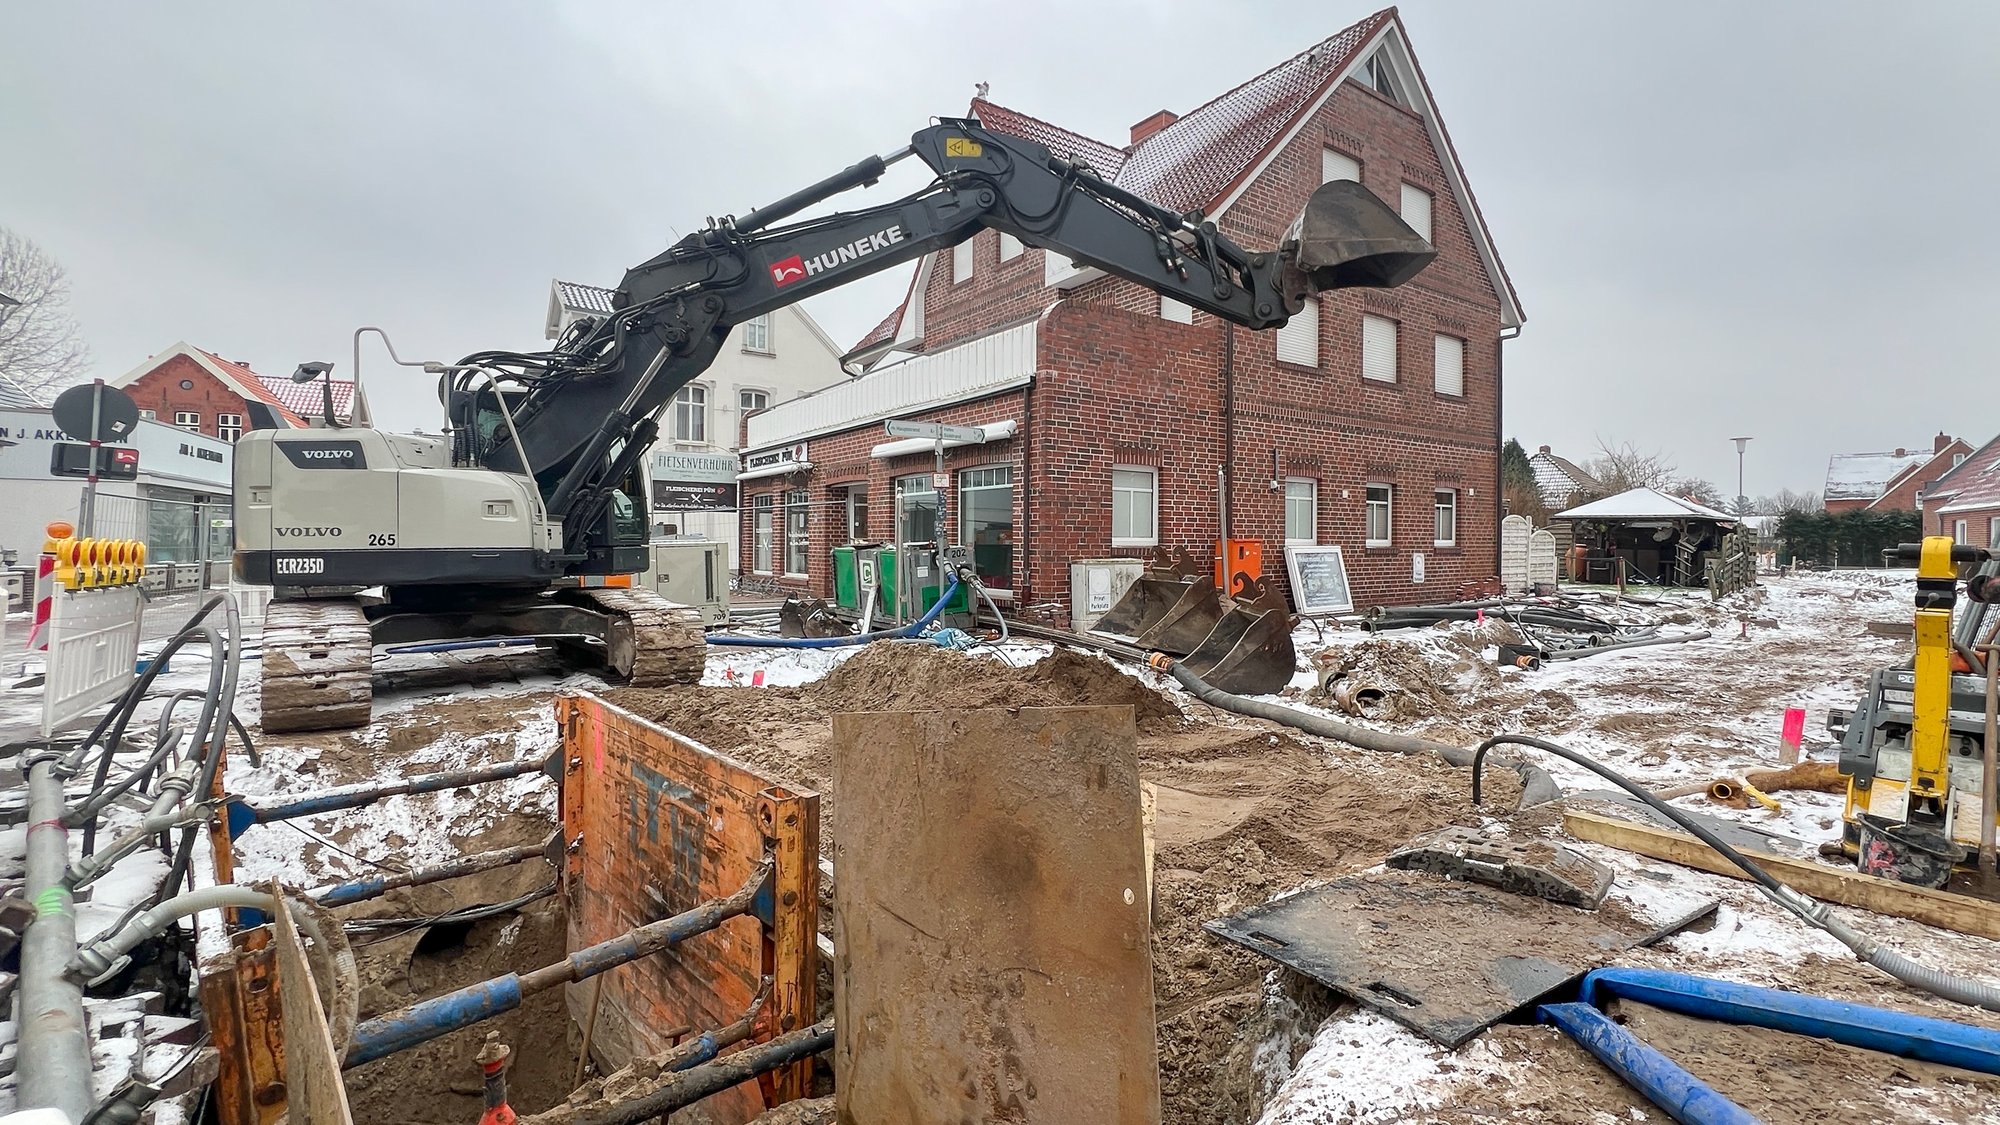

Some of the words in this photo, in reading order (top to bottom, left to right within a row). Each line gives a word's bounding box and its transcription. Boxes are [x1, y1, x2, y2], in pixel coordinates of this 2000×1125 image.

[804, 225, 904, 276] HUNEKE
[302, 450, 353, 459] VOLVO
[274, 527, 342, 537] VOLVO
[368, 534, 395, 546] 265
[951, 549, 967, 558] 202
[277, 558, 324, 574] ECR235D
